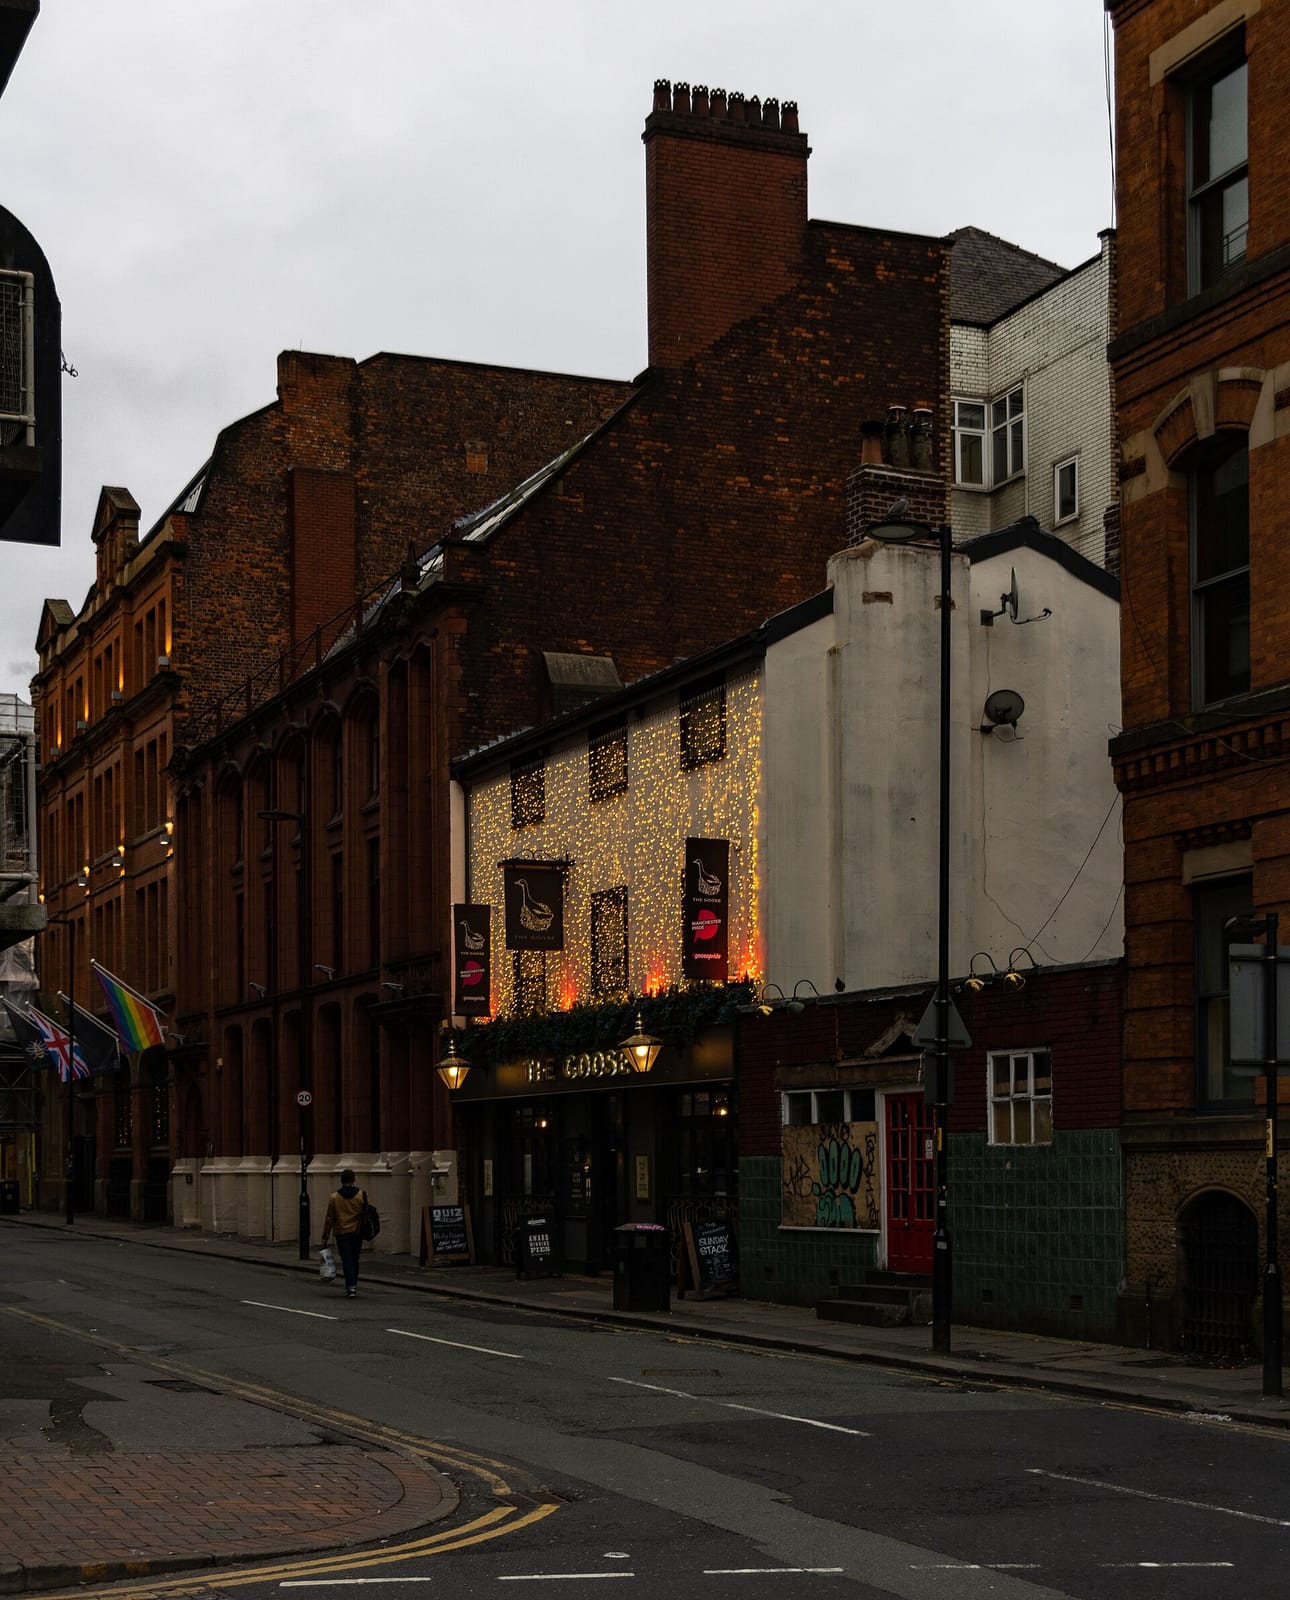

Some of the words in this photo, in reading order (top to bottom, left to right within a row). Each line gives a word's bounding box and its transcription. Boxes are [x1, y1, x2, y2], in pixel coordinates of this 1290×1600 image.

[691, 919, 722, 927] MANCHESTER
[523, 1057, 557, 1082] THE
[563, 1050, 631, 1079] GOOSE
[299, 1094, 311, 1102] 20
[432, 1207, 464, 1218] QUIZ
[528, 1233, 549, 1241] AWARD
[698, 1234, 729, 1246] SUNDAY
[699, 1244, 729, 1256] STACK
